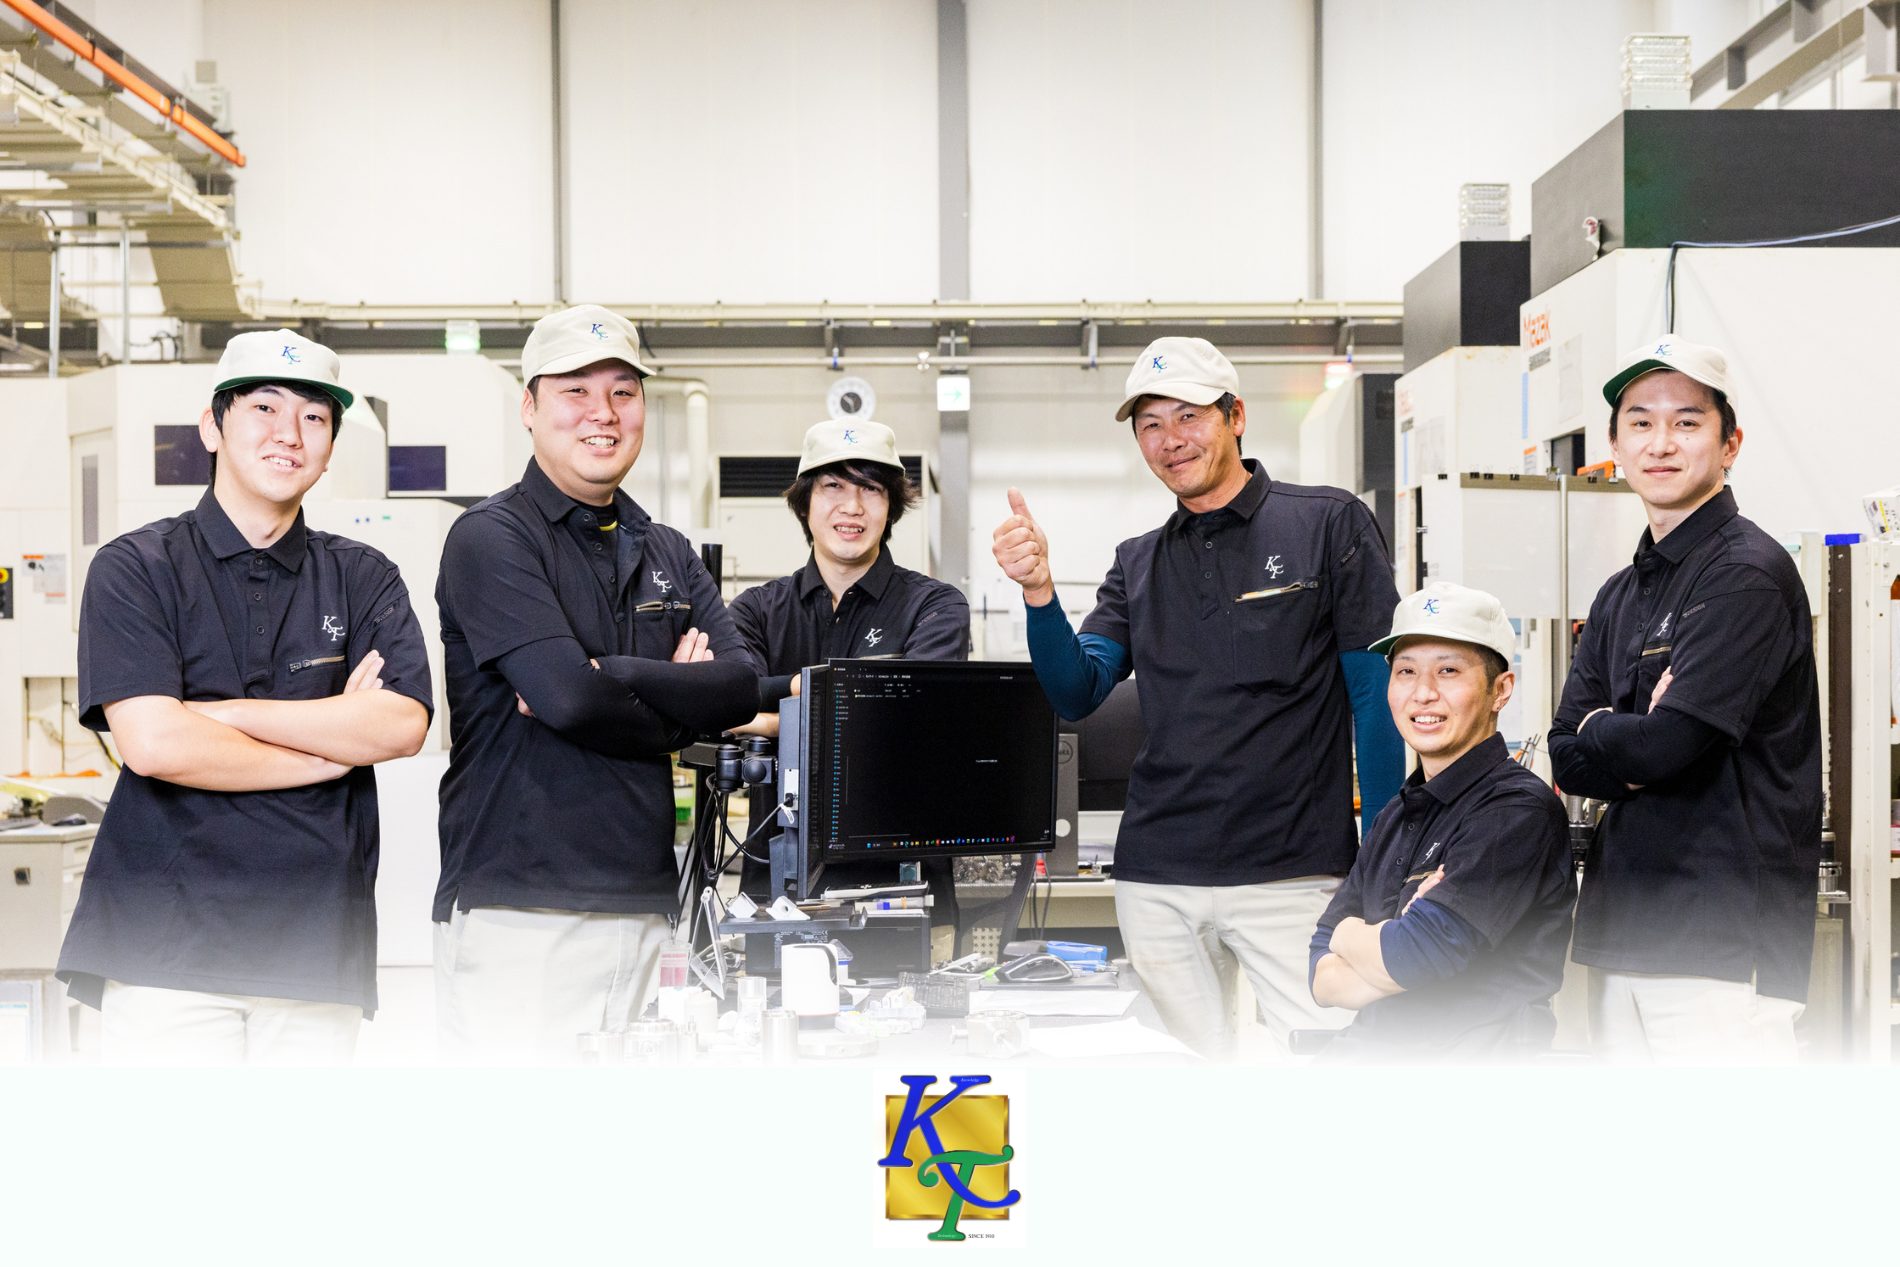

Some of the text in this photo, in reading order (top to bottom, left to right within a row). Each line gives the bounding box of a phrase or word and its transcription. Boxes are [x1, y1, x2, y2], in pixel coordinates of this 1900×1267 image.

[1264, 555, 1284, 579] KT
[652, 570, 672, 593] KT
[321, 615, 346, 641] KT
